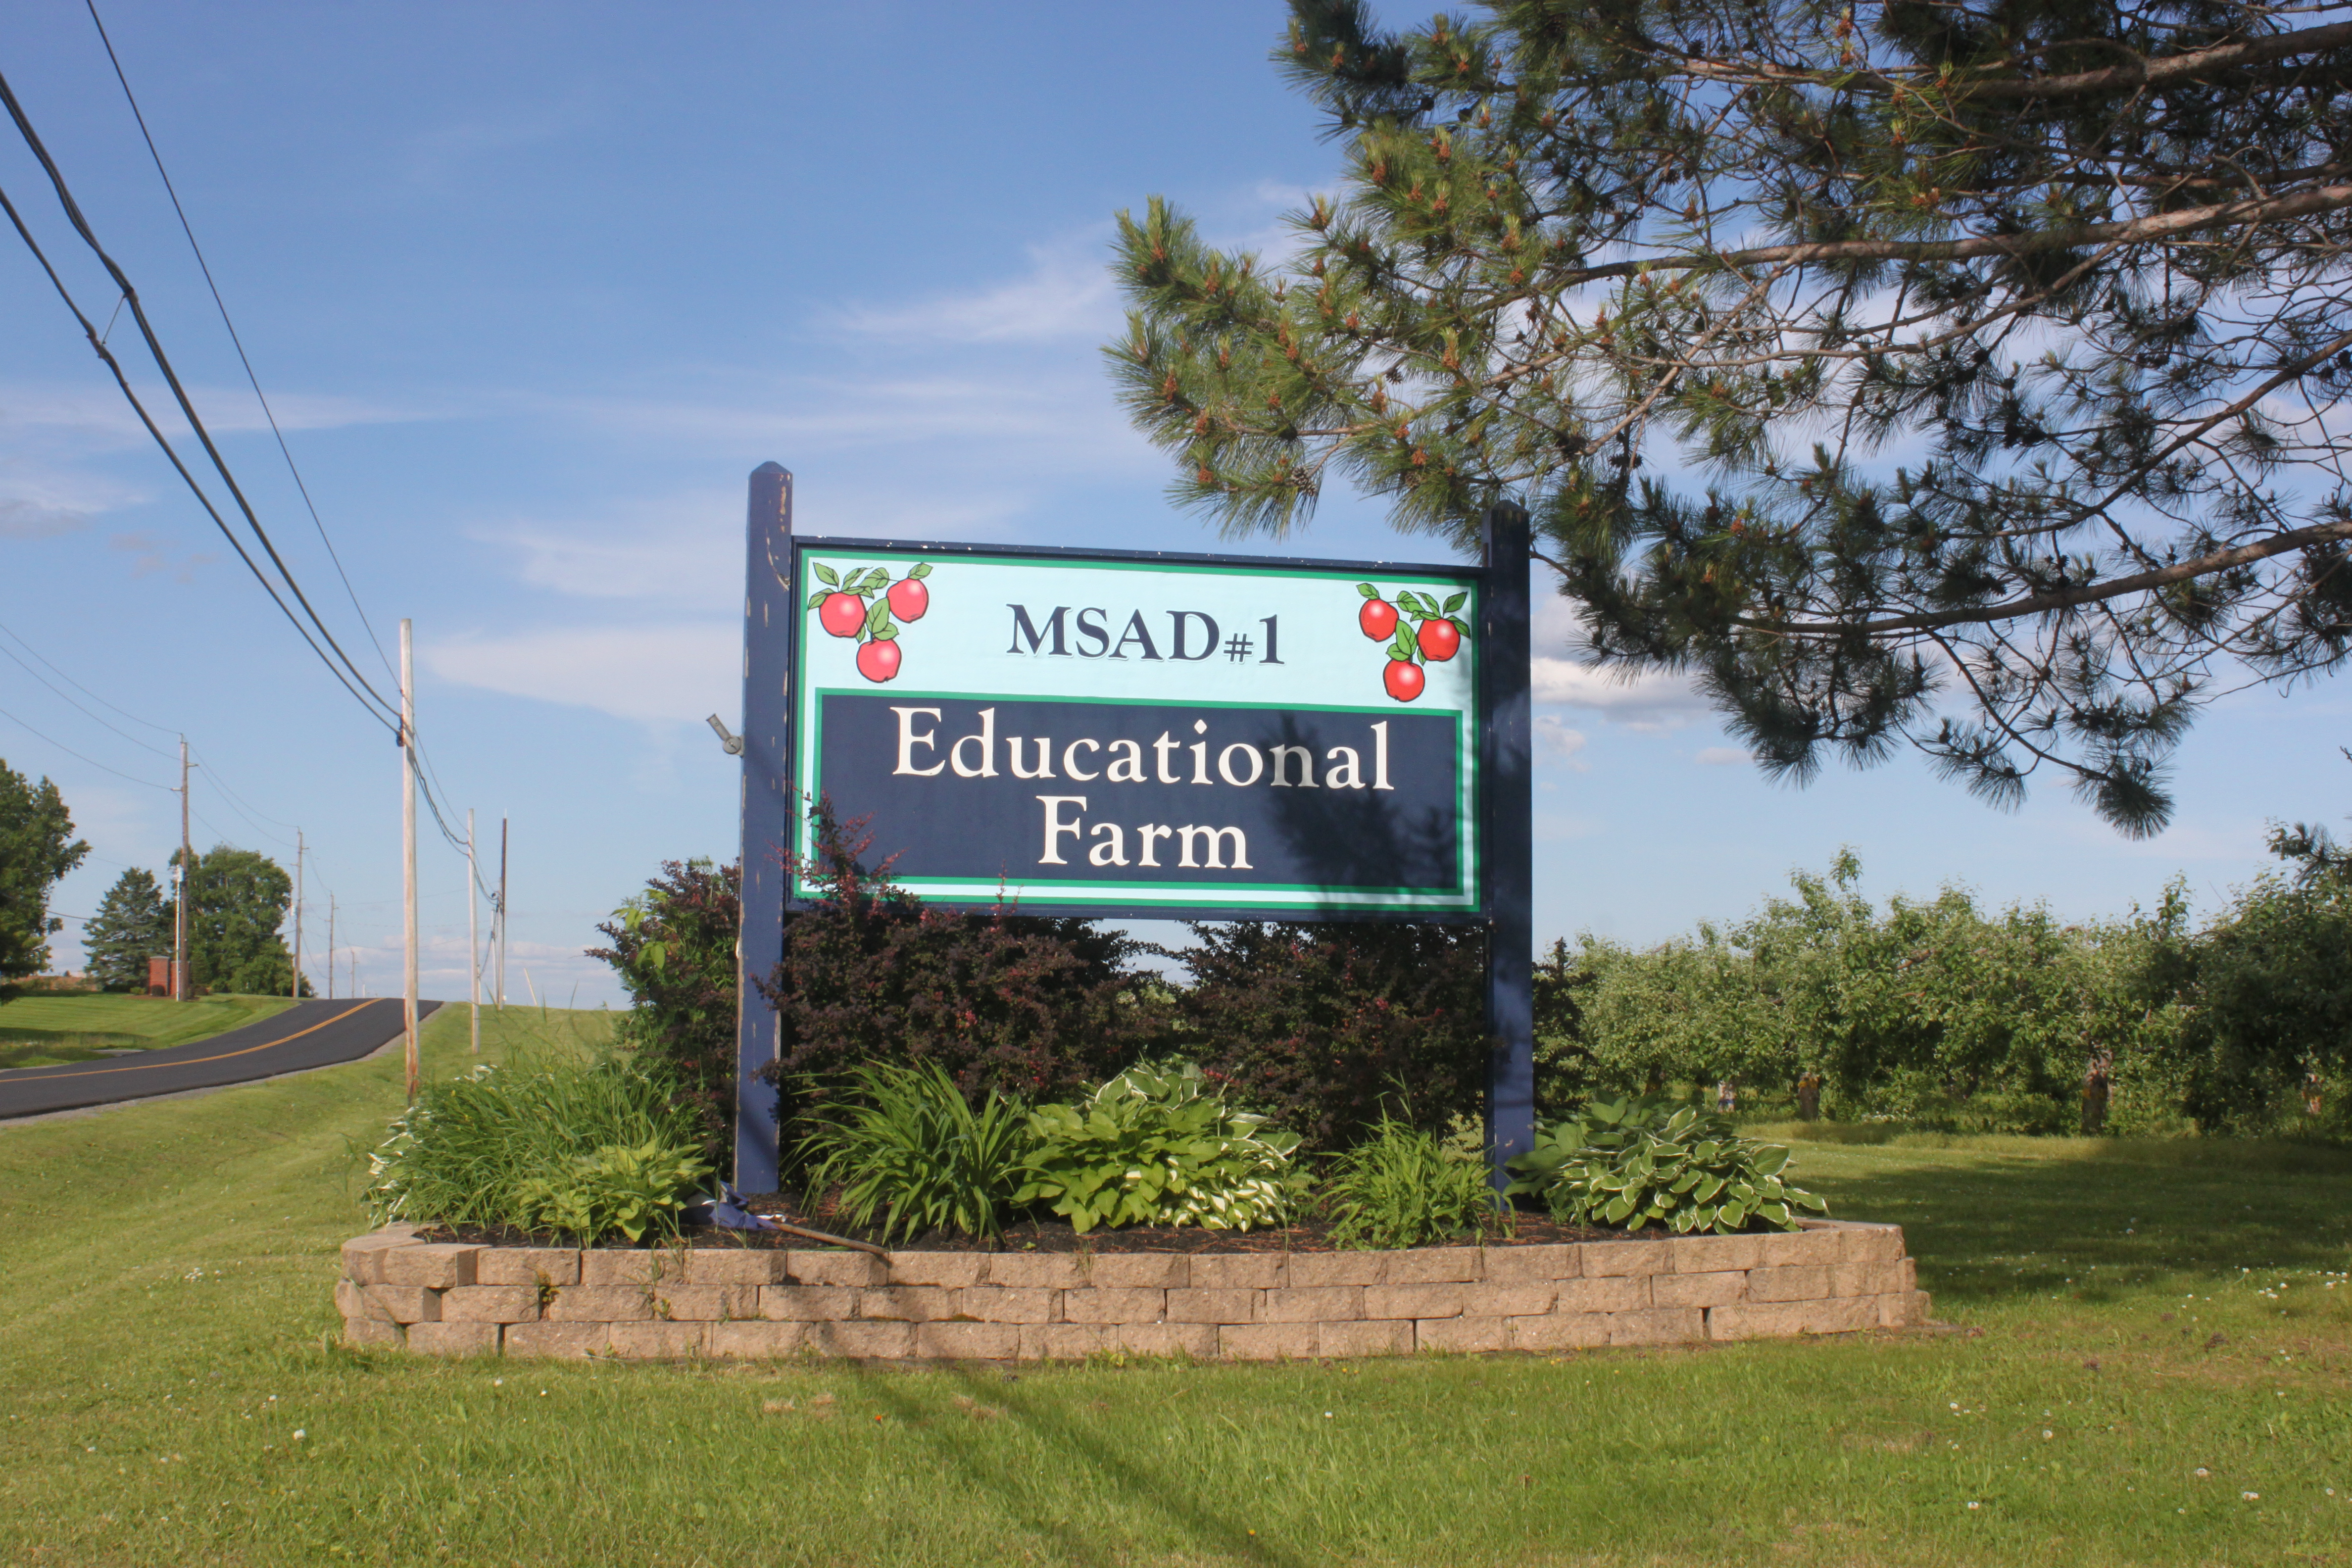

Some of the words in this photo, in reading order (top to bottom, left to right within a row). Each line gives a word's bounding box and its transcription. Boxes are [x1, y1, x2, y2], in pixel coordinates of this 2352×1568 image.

[1007, 604, 1285, 664] MSAD#1
[891, 707, 1394, 790] Educational
[1036, 795, 1254, 869] Farm
